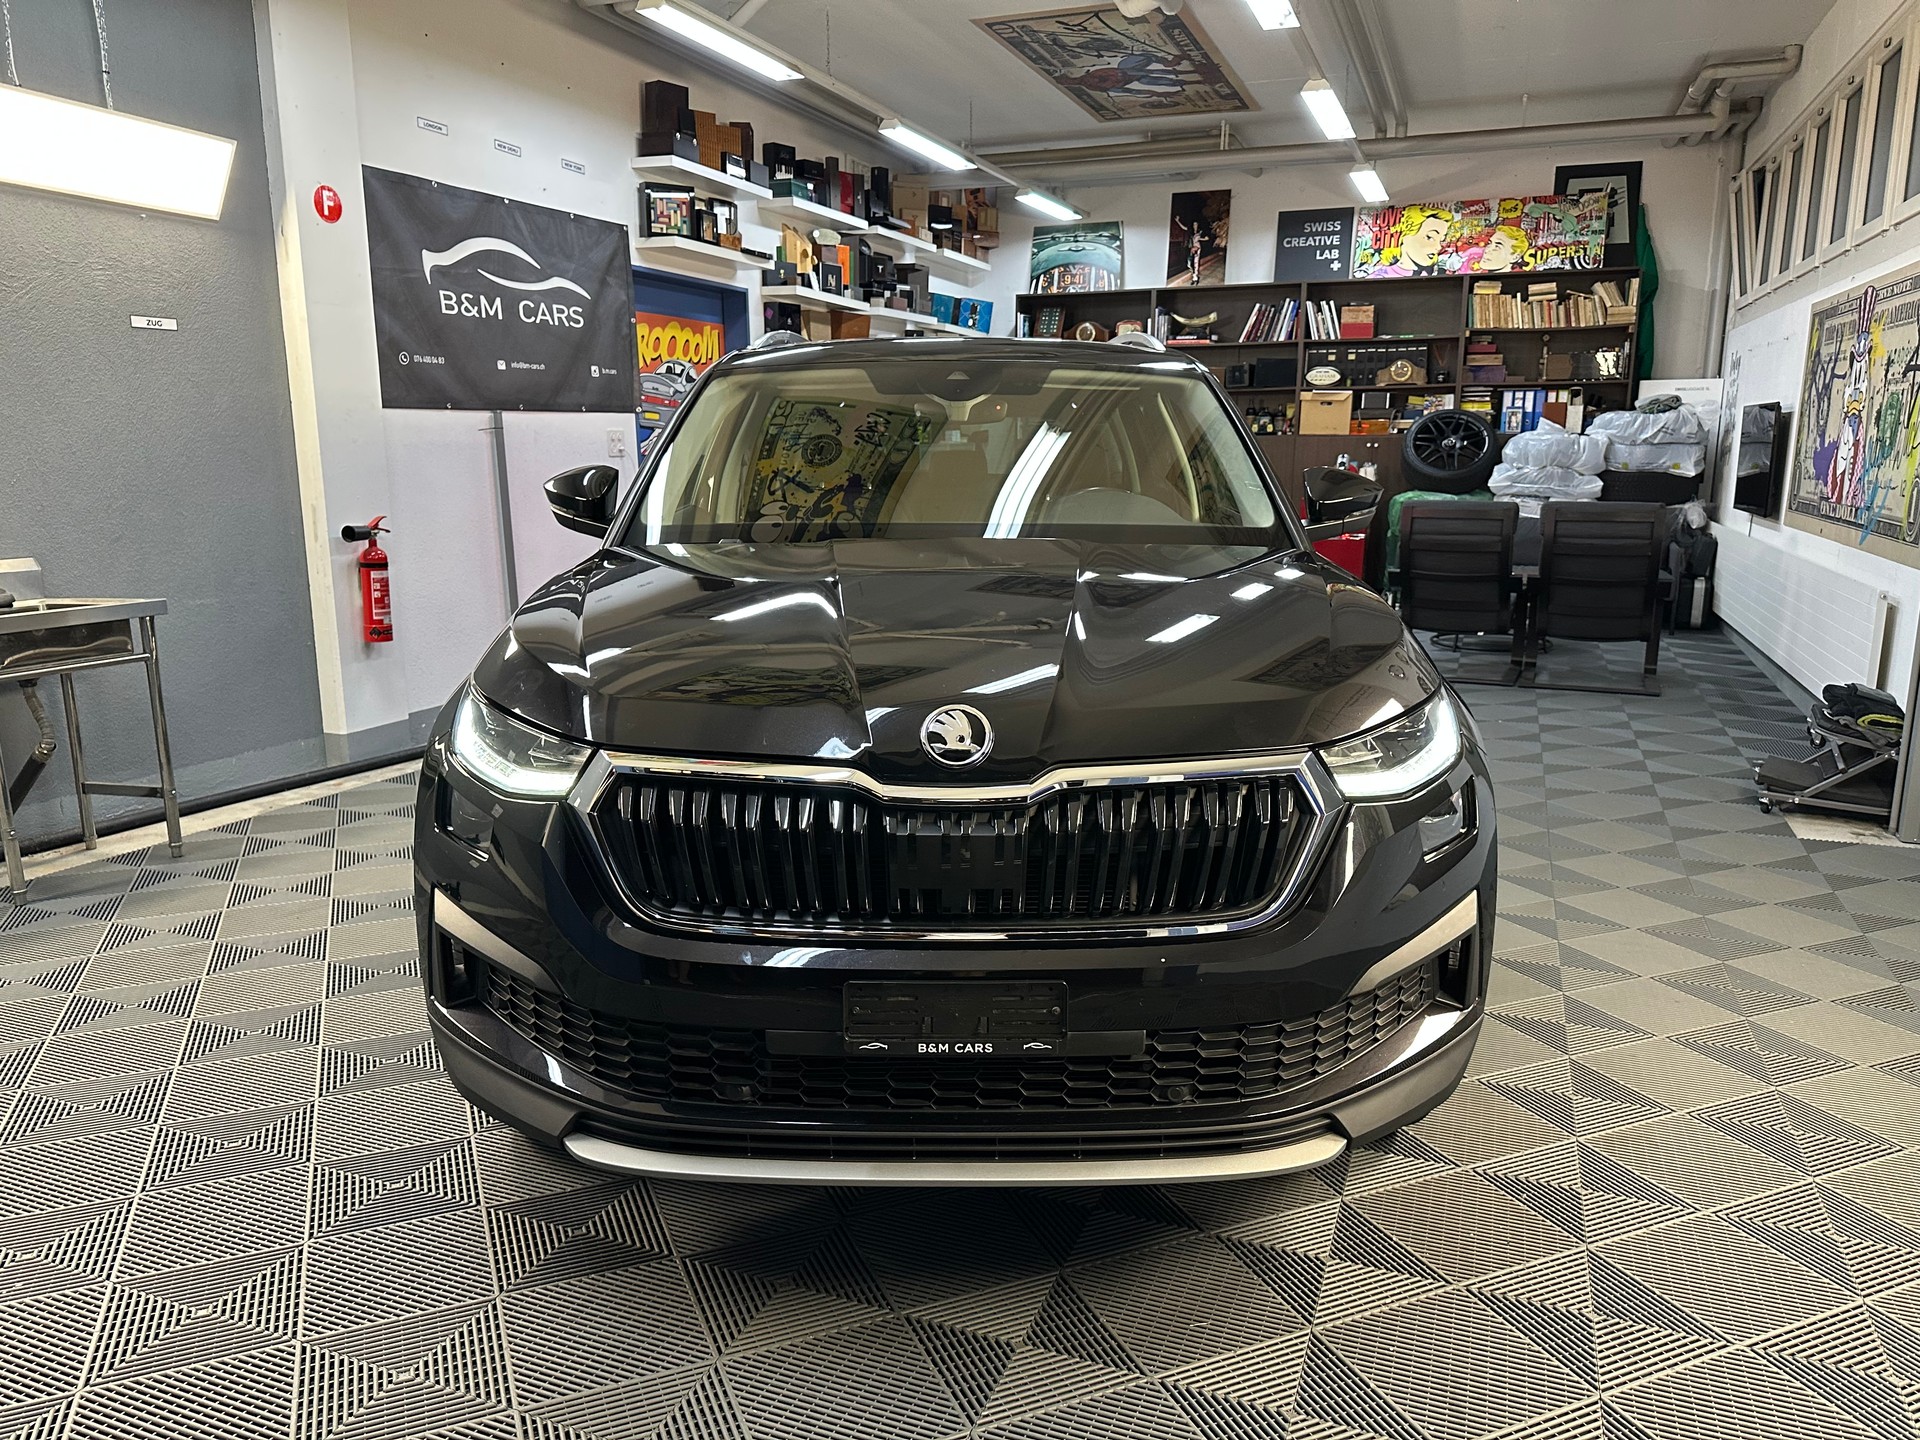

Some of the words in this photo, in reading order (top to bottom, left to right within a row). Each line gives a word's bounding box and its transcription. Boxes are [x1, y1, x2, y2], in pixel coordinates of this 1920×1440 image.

[422, 121, 443, 132] LONDON
[496, 142, 507, 151] NEW
[564, 161, 573, 169] NEW
[573, 163, 582, 171] YORK
[322, 190, 334, 216] F
[1373, 207, 1403, 227] LOVE
[1303, 221, 1341, 233] SWISS
[1283, 235, 1341, 248] CREATIVE
[1372, 229, 1400, 250] CITY
[1316, 249, 1339, 260] LAB
[827, 274, 837, 287] N
[438, 289, 503, 321] B&M
[518, 299, 585, 329] CARS
[145, 319, 163, 327] ZUG
[1820, 500, 1835, 517] ONE
[917, 1043, 949, 1053] B&M
[954, 1043, 994, 1053] CARS
